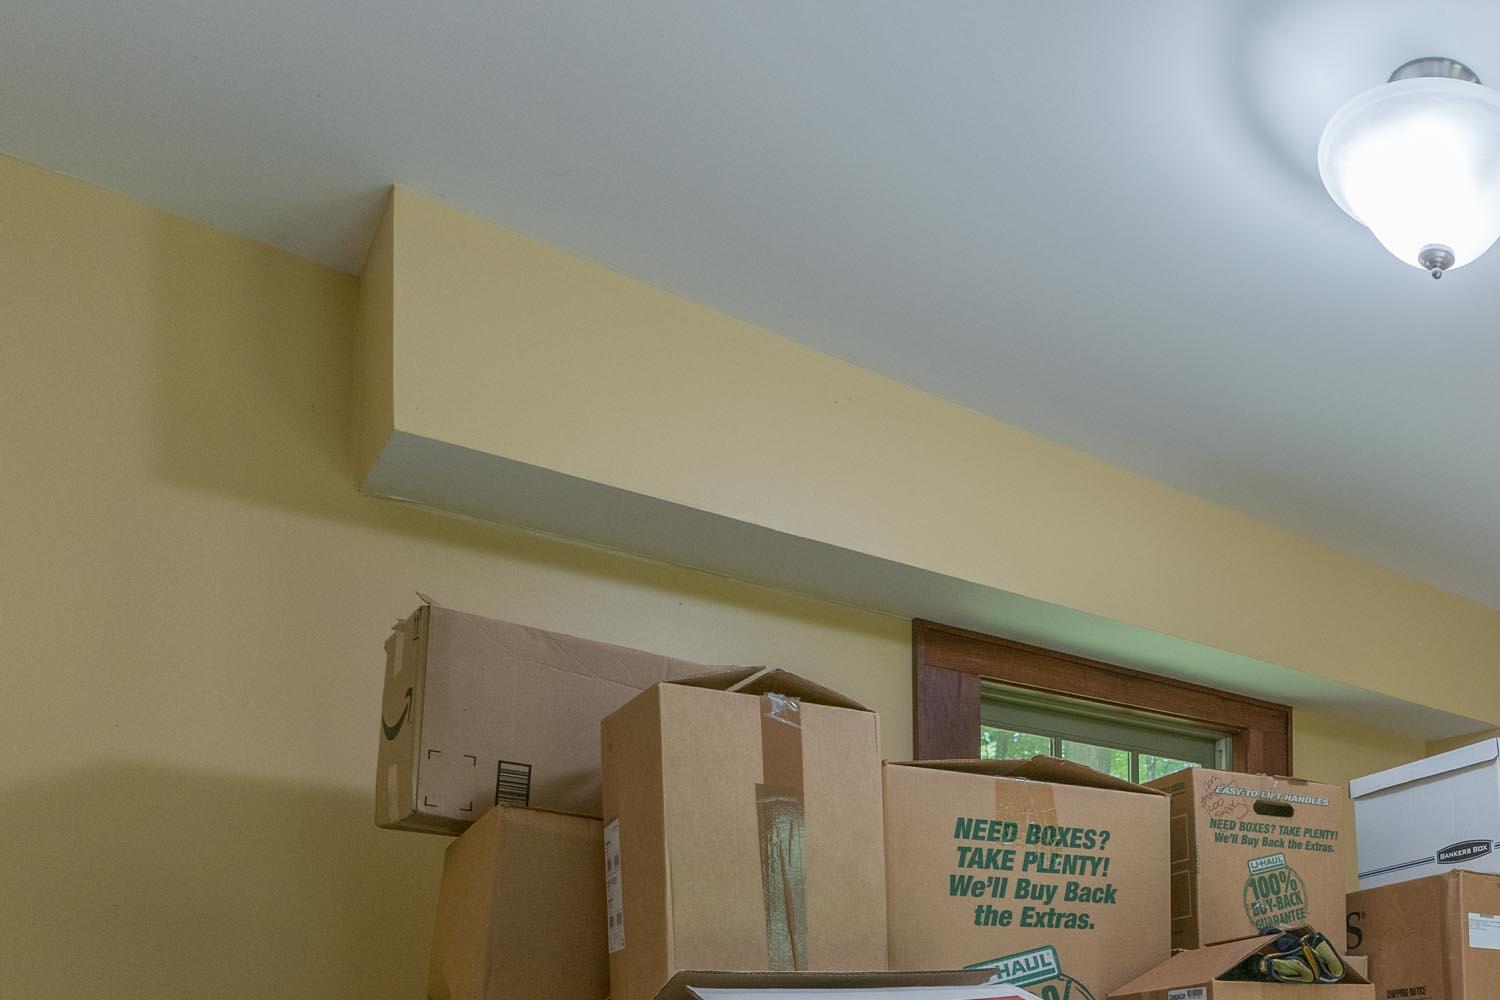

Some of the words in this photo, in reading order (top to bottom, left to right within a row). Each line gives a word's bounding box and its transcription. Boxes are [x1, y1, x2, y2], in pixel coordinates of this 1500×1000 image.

[1285, 794, 1329, 806] HANDLES
[954, 817, 1018, 842] NEED
[1026, 822, 1110, 850] BOXES?
[1210, 818, 1236, 830] NEED
[1239, 822, 1275, 834] BOXES?
[1279, 825, 1301, 837] TAKE
[1304, 828, 1338, 840] PLENTY!
[1214, 832, 1238, 844] We'll
[1241, 836, 1259, 848] Buy
[1262, 837, 1284, 849] Back
[1288, 840, 1302, 850] the
[1305, 841, 1334, 852] Extras.
[1440, 848, 1471, 860] BANKERS
[1472, 844, 1487, 852] BOX
[957, 846, 1016, 870] TAKE
[1022, 851, 1110, 877] PLENTY!
[1250, 856, 1283, 869] U-HAUL
[950, 874, 1006, 898] We'll
[1014, 878, 1058, 905] Buy
[1064, 882, 1117, 904] Back
[1249, 872, 1298, 900] 100%
[974, 904, 1012, 927] the
[1020, 906, 1094, 930] Extras.
